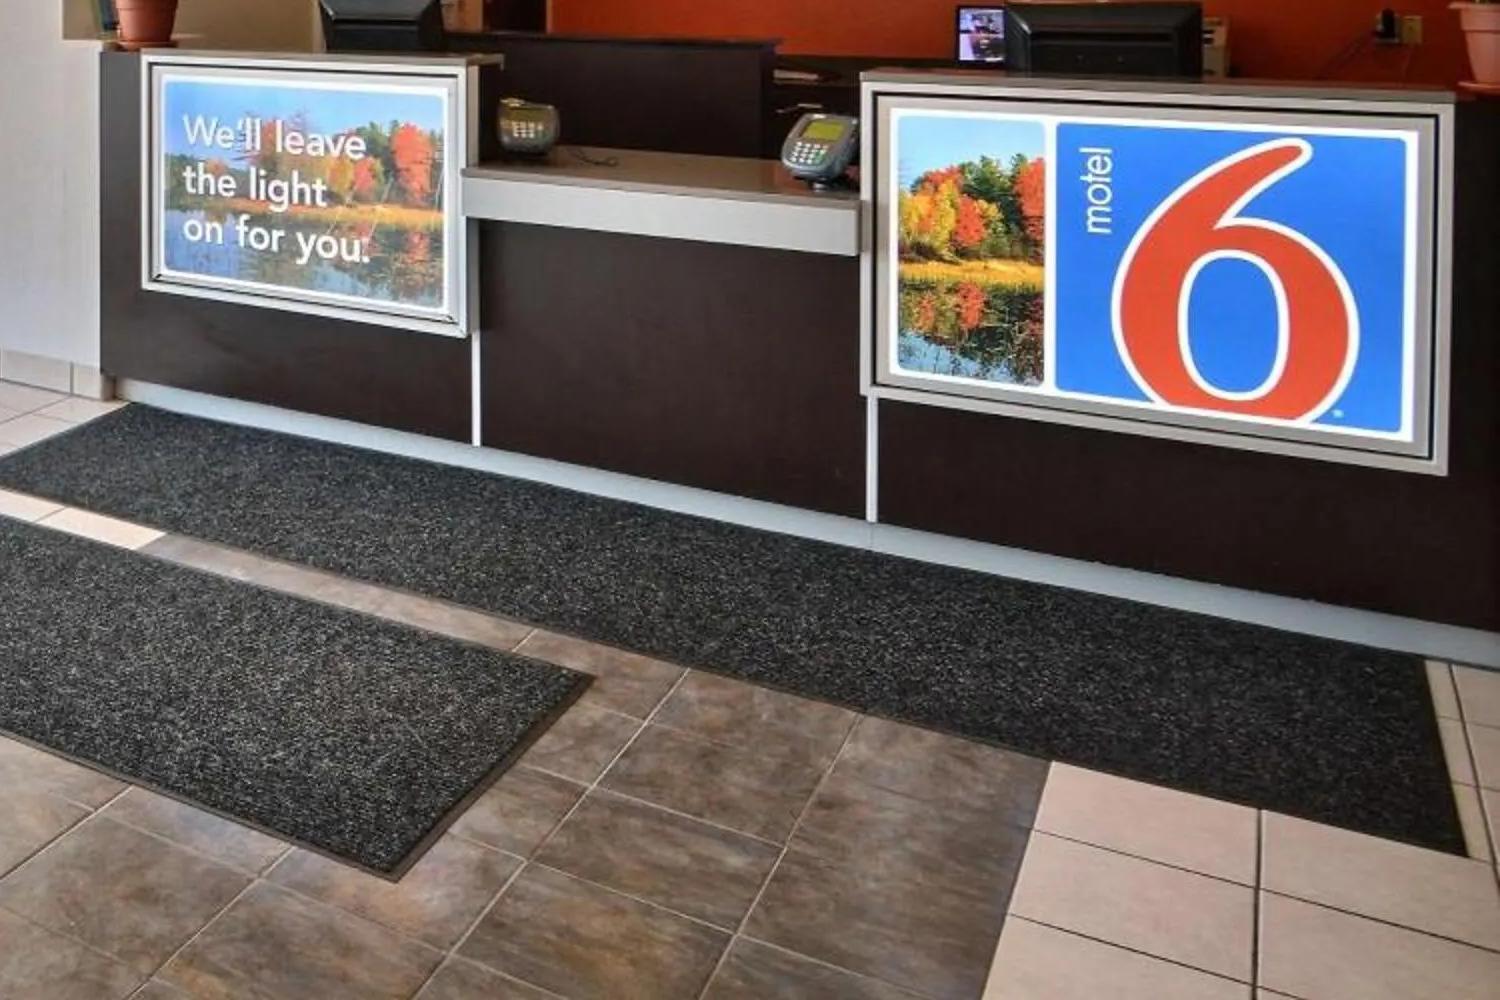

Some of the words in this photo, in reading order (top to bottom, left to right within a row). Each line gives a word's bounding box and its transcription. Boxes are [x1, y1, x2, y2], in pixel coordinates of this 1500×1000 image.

[182, 114, 261, 151] We'll
[275, 119, 366, 160] leave
[182, 162, 236, 197] the
[250, 166, 328, 212] light
[183, 219, 223, 245] on
[236, 215, 285, 252] for
[295, 232, 370, 264] you.
[1078, 146, 1113, 234] motel
[1111, 137, 1360, 424] 6
